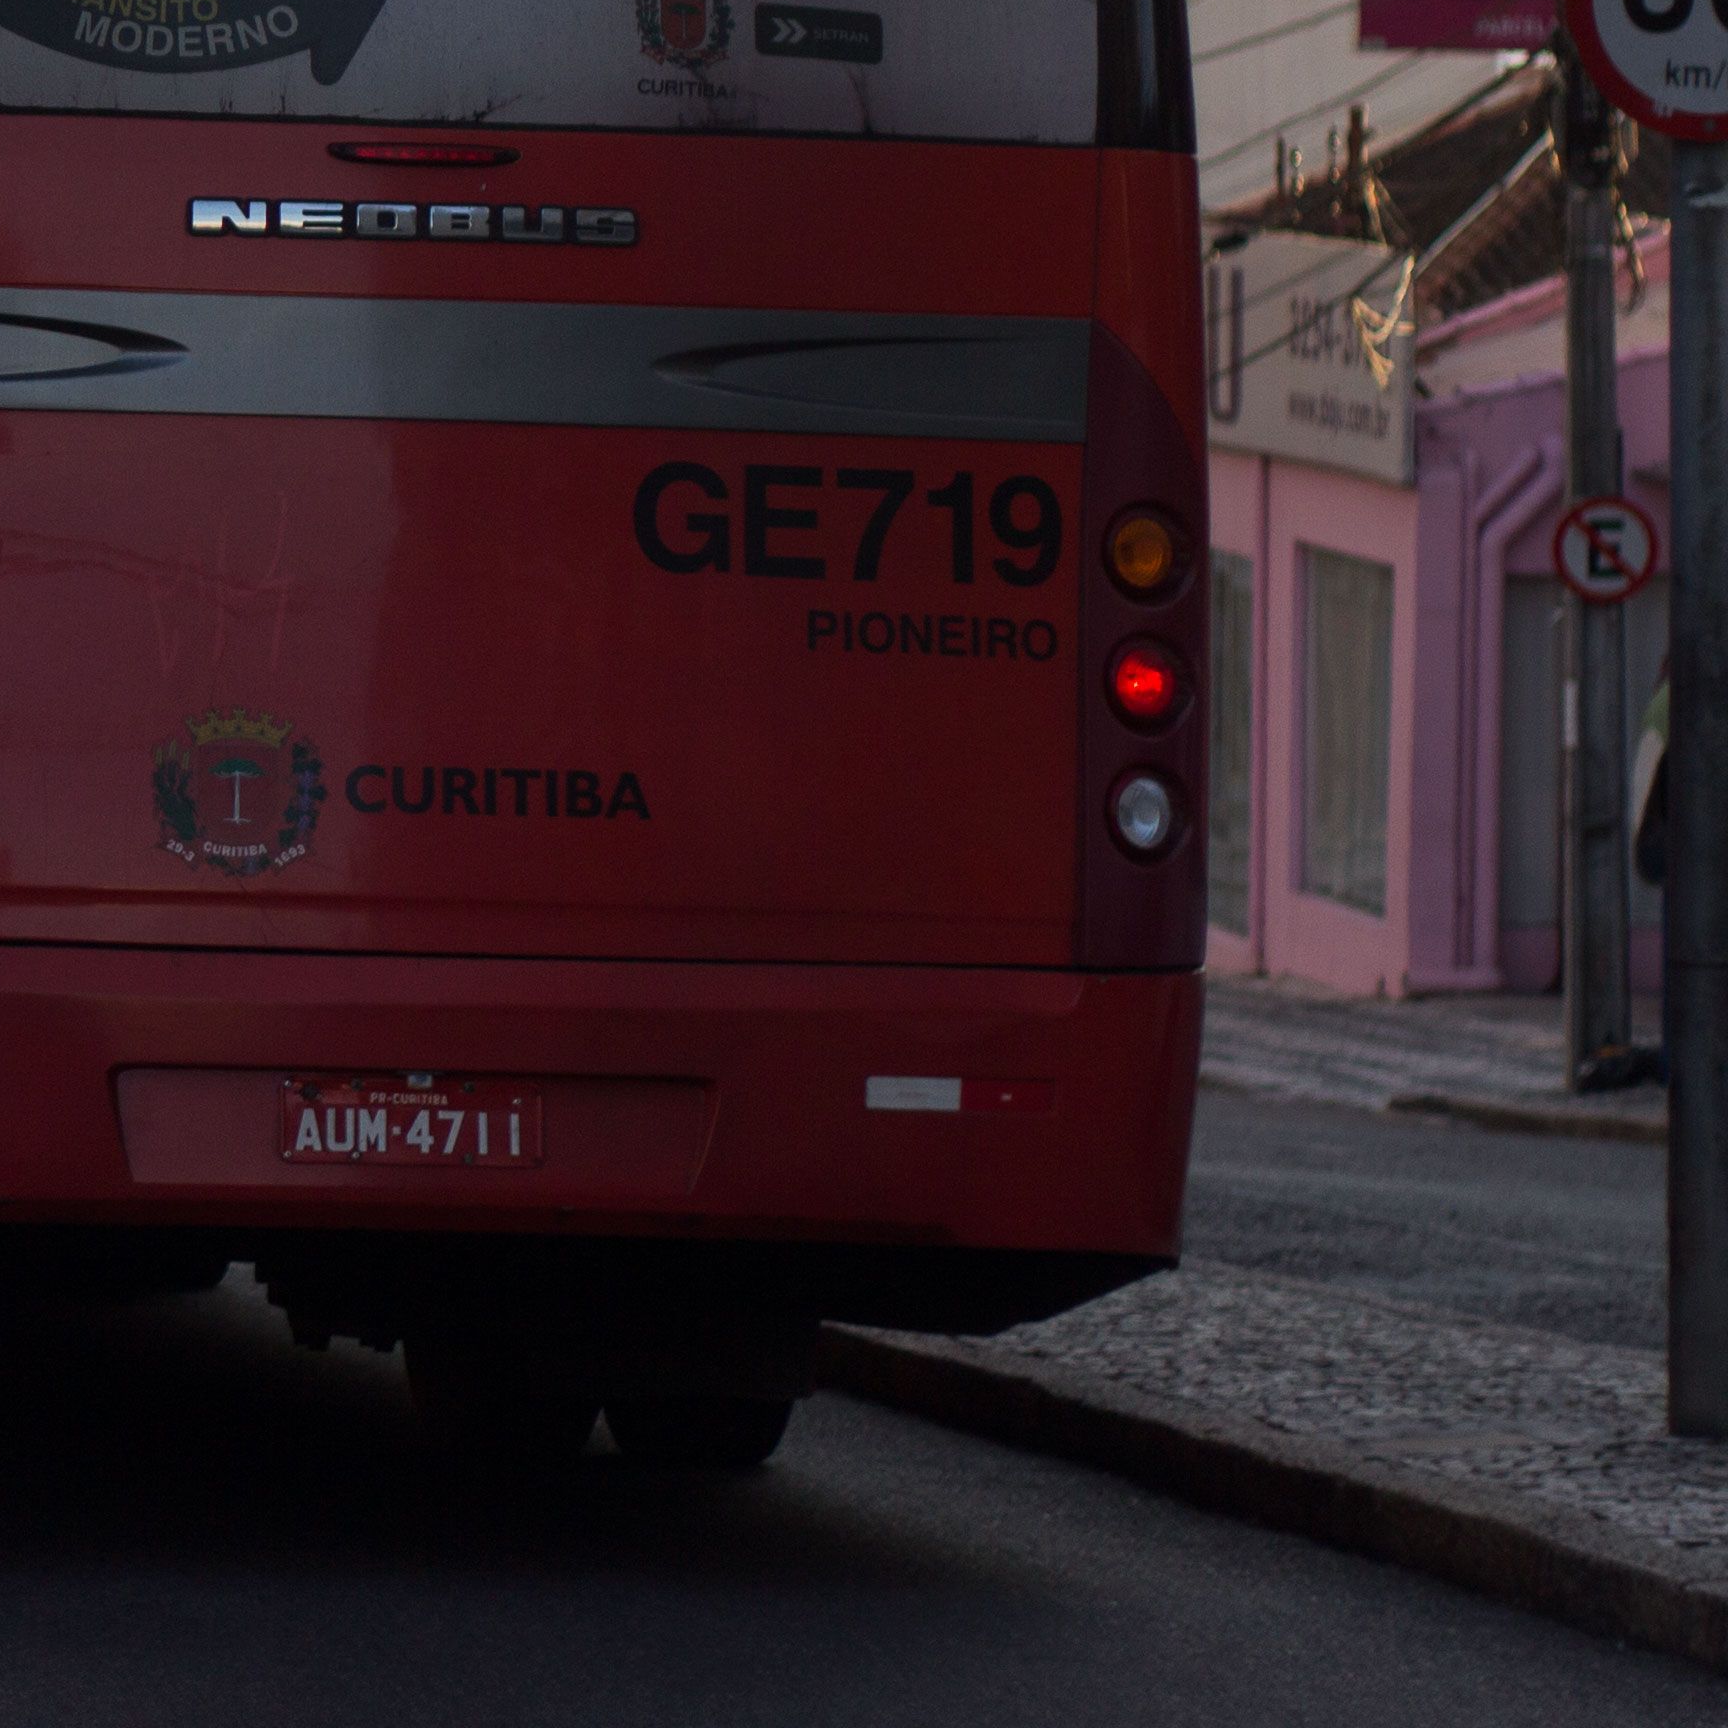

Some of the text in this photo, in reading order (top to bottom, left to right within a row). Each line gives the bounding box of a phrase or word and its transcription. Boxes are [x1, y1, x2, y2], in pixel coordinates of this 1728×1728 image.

[73, 5, 299, 58] MODERNO
[811, 27, 870, 44] SETRAN
[637, 78, 729, 100] CURITIBA
[189, 197, 639, 246] NEOBUS
[632, 461, 1064, 588] GE719
[806, 609, 1058, 661] PIONEIRO
[344, 765, 652, 821] CURITIBA
[202, 840, 268, 858] CURITIBA
